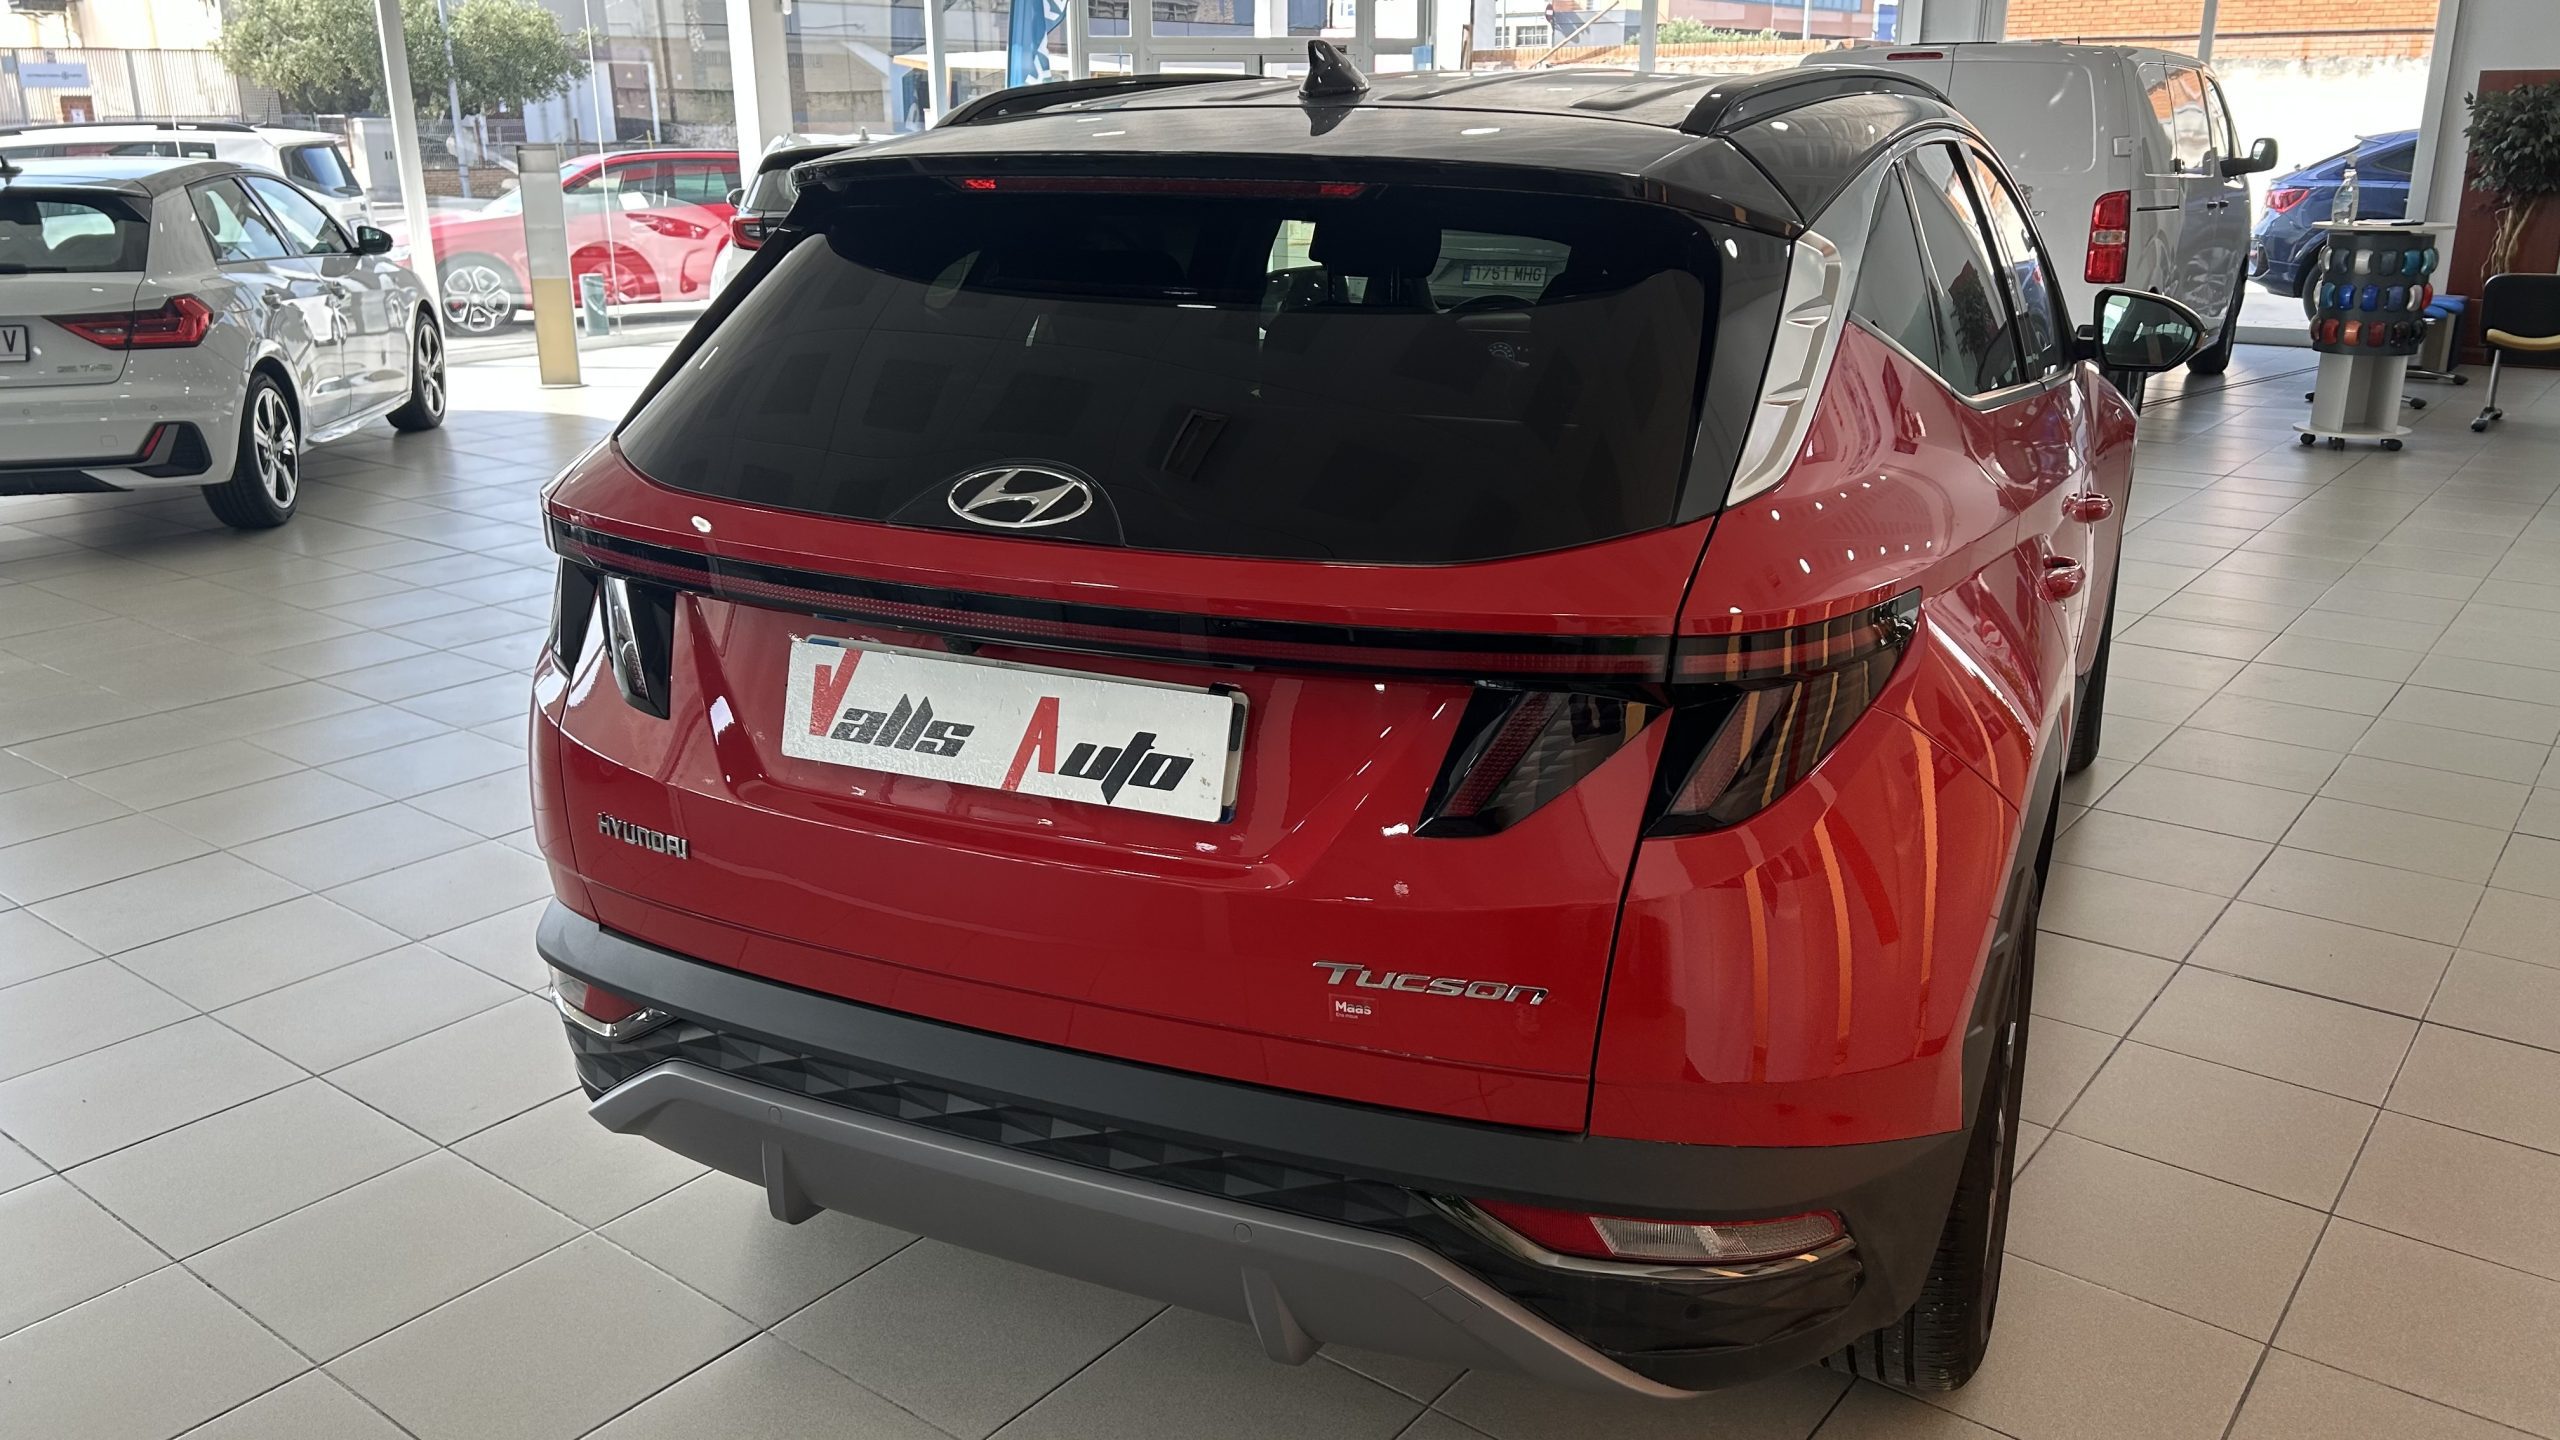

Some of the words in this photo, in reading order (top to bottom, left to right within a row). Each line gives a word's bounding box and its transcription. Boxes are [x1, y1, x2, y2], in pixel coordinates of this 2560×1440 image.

[809, 648, 975, 758] Valls
[1001, 696, 1194, 805] Auto
[597, 811, 688, 860] HYUNDAI
[1335, 1000, 1372, 1016] Maas
